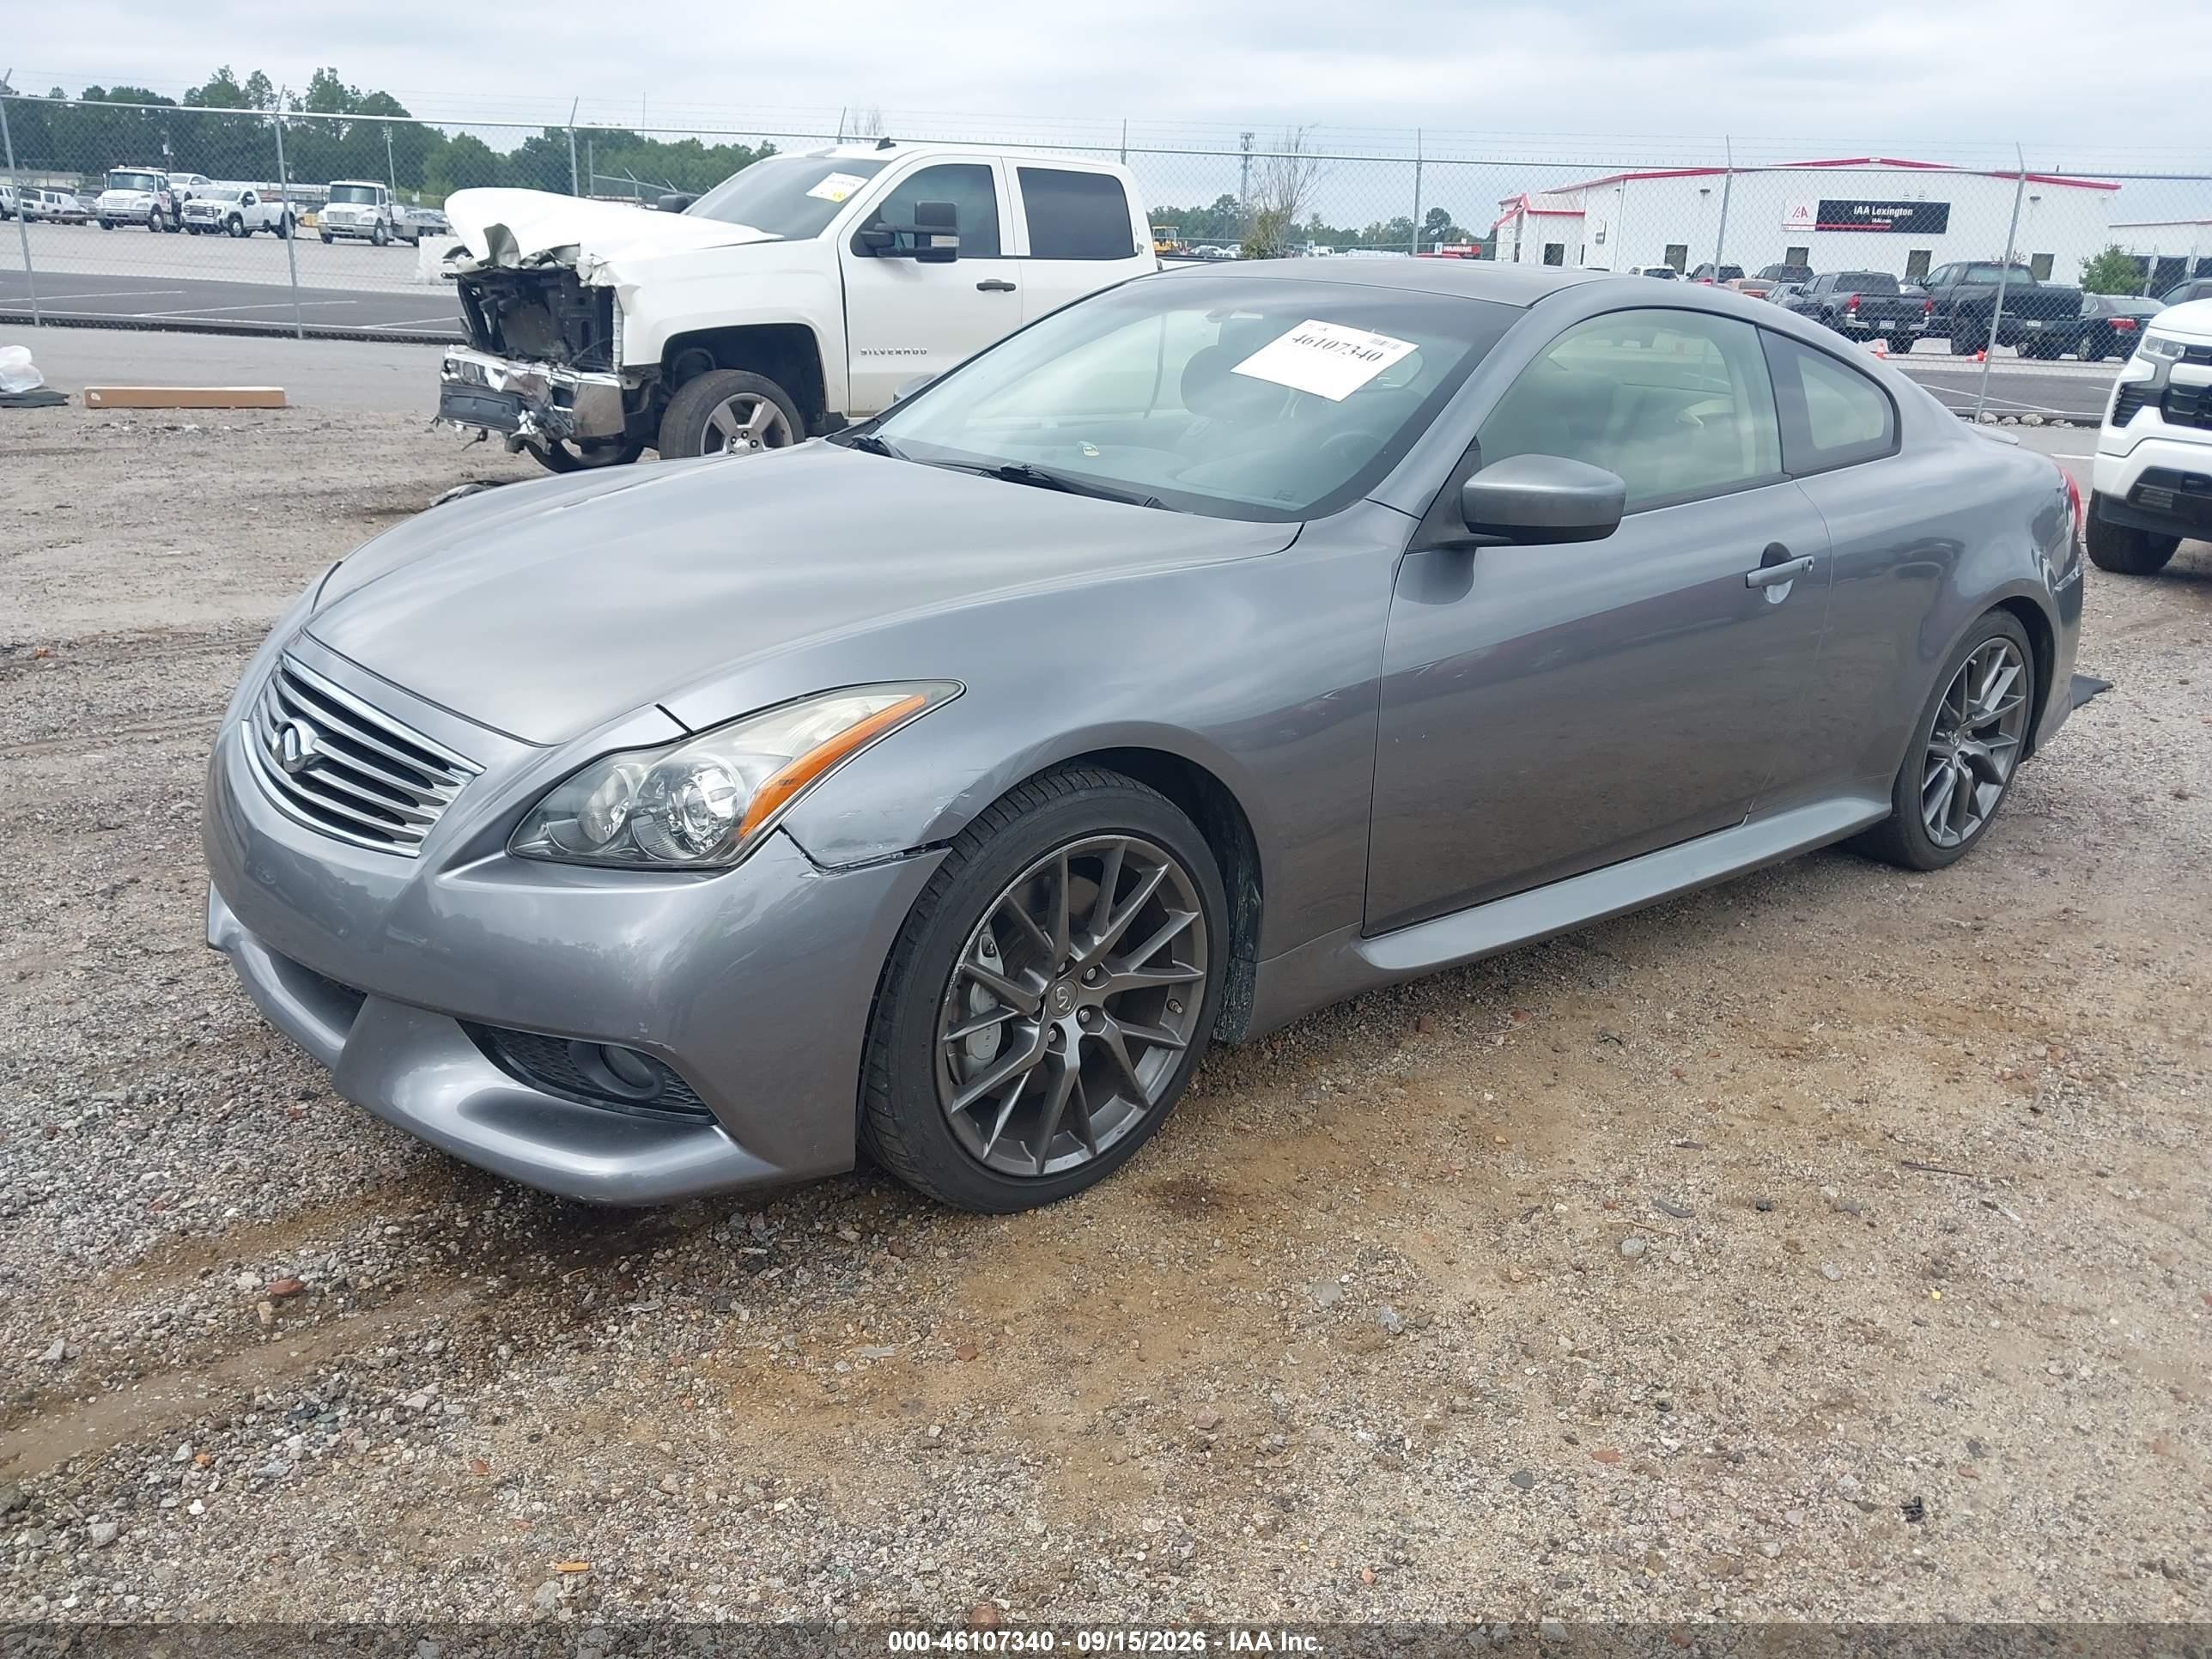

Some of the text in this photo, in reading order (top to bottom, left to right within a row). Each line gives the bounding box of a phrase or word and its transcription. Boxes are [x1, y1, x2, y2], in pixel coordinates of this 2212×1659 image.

[1853, 205, 1913, 217] IAA Lexington
[860, 347, 927, 356] SILVERADO
[1291, 333, 1384, 362] 46107340
